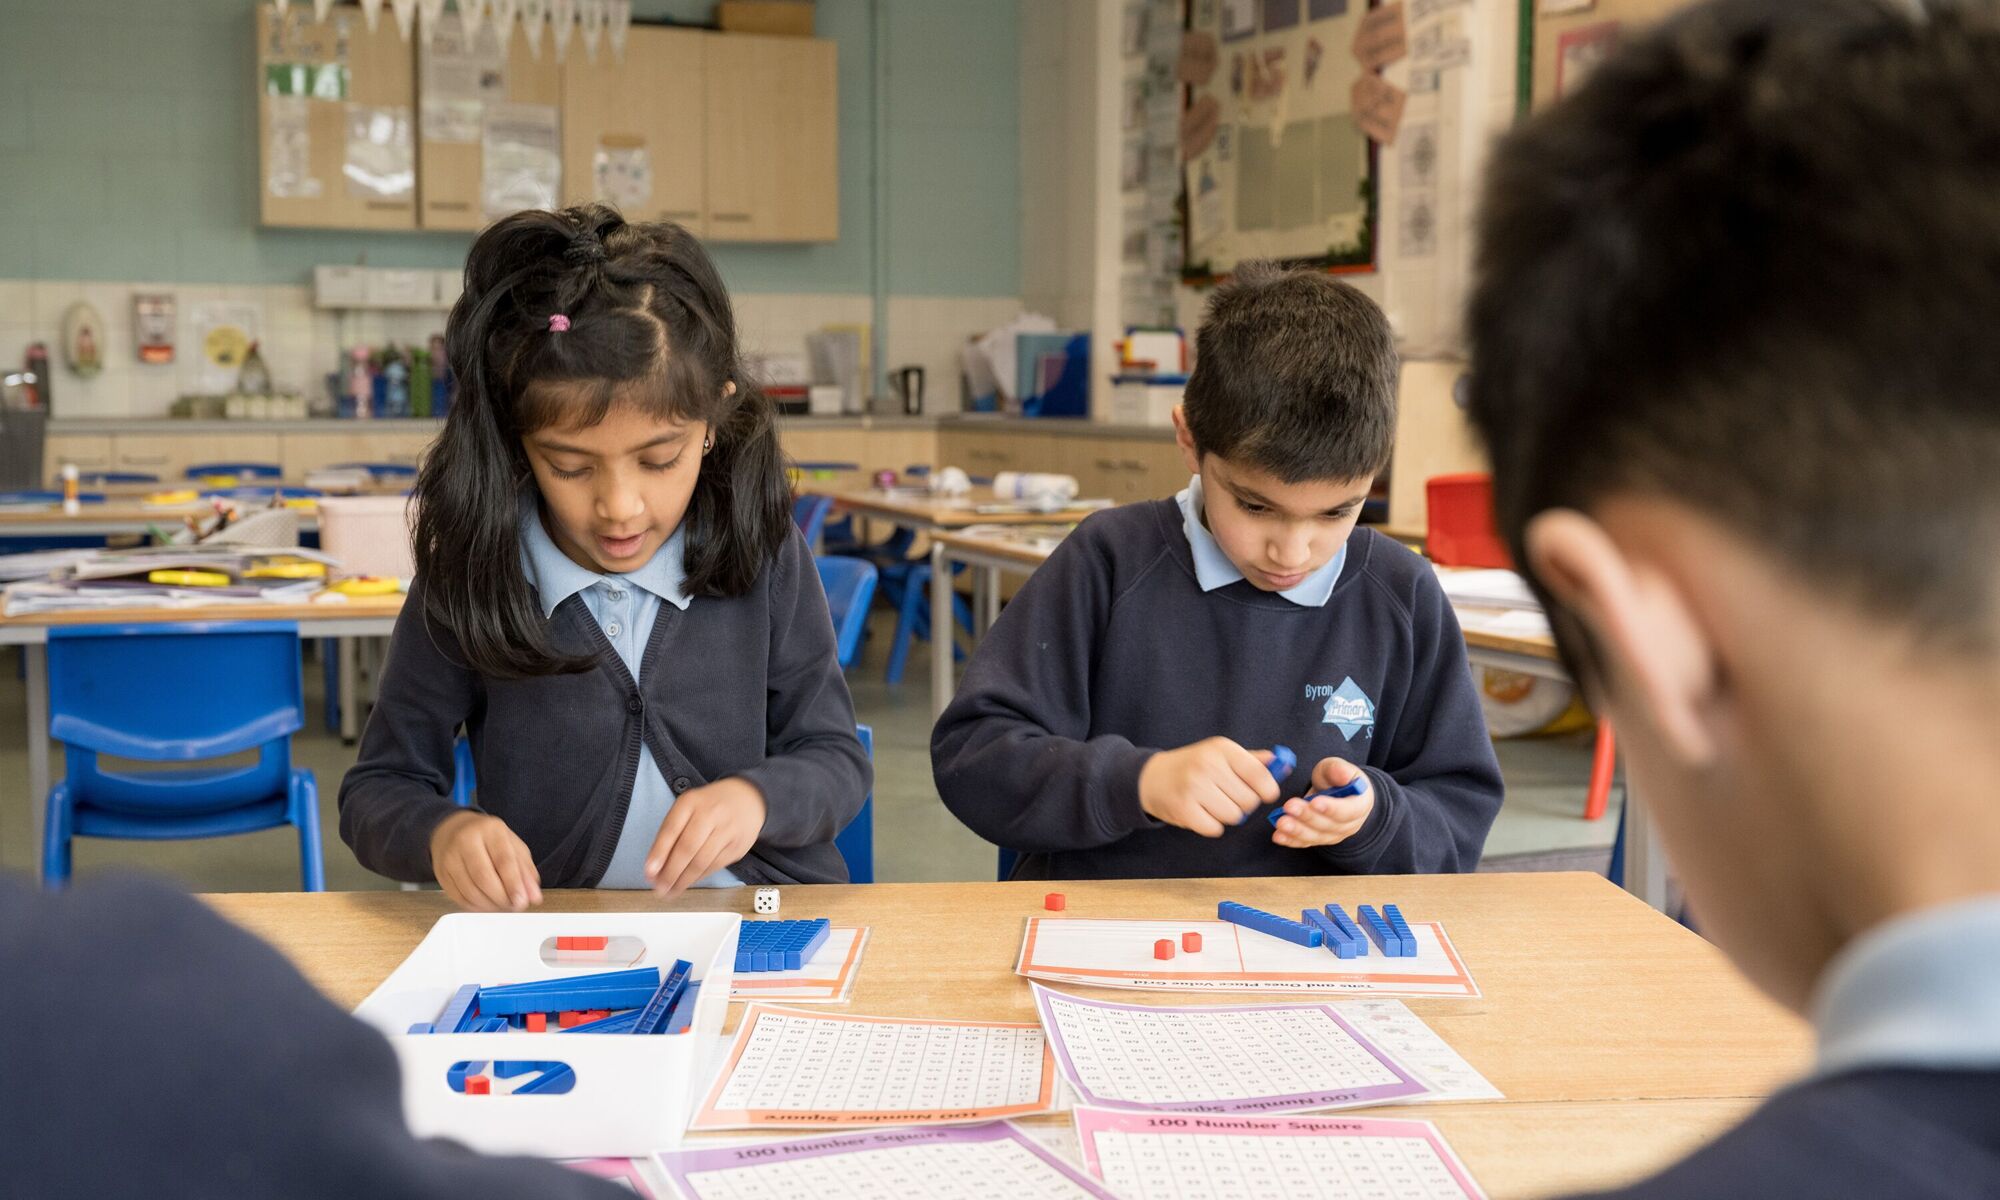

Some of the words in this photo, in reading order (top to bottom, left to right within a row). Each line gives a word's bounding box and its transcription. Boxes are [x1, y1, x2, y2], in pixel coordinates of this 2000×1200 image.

[1305, 684, 1334, 701] Byron
[1320, 1093, 1359, 1102] 100
[1232, 1098, 1315, 1111] Number
[764, 1114, 839, 1122] Square
[847, 1114, 933, 1122] Number
[939, 1112, 979, 1120] 100
[1147, 1119, 1188, 1128] 100
[1196, 1120, 1281, 1130] Number
[1288, 1122, 1364, 1132] Square
[733, 1148, 777, 1160] 100
[783, 1138, 867, 1154] Number
[874, 1131, 947, 1144] Square
